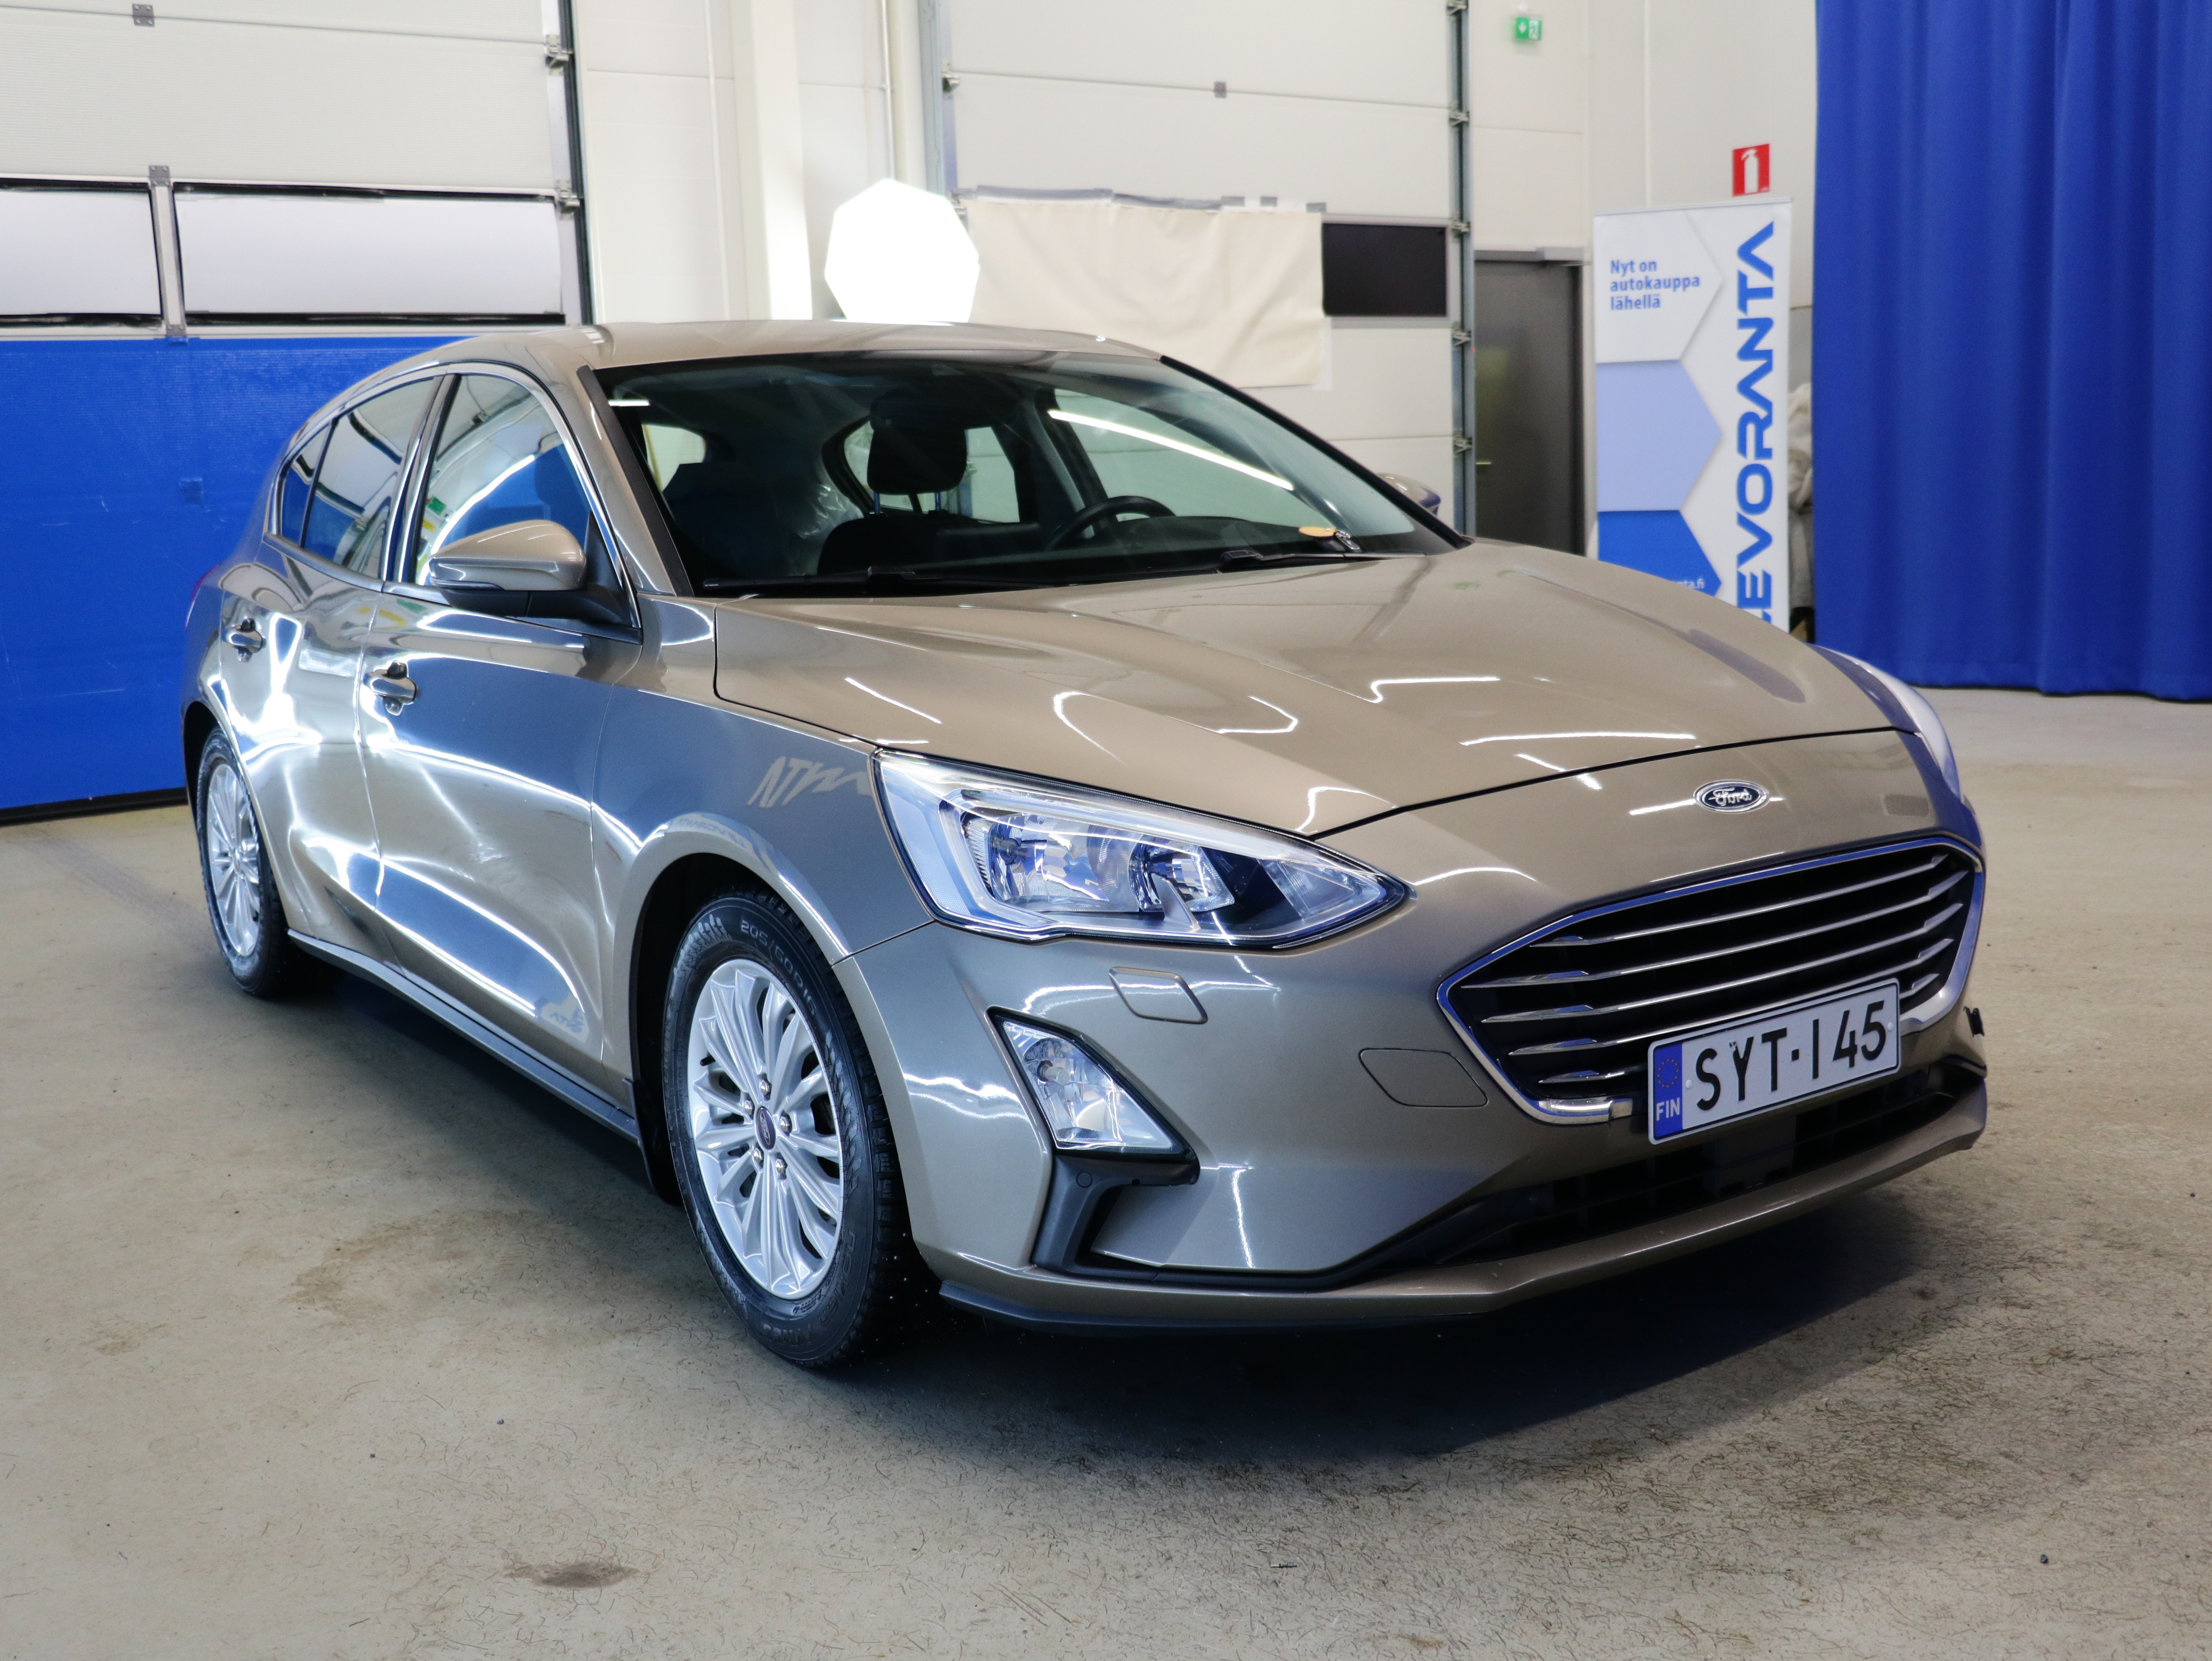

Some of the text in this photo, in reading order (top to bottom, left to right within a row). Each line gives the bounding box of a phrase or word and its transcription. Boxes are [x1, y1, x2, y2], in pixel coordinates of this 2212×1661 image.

[1610, 260, 1657, 277] Nyt on
[1610, 275, 1701, 292] autokauppa
[1610, 294, 1661, 311] lähellä
[1736, 220, 1774, 624] EVORANTA
[1708, 787, 1753, 806] Ford
[1656, 1097, 1680, 1121] FIN
